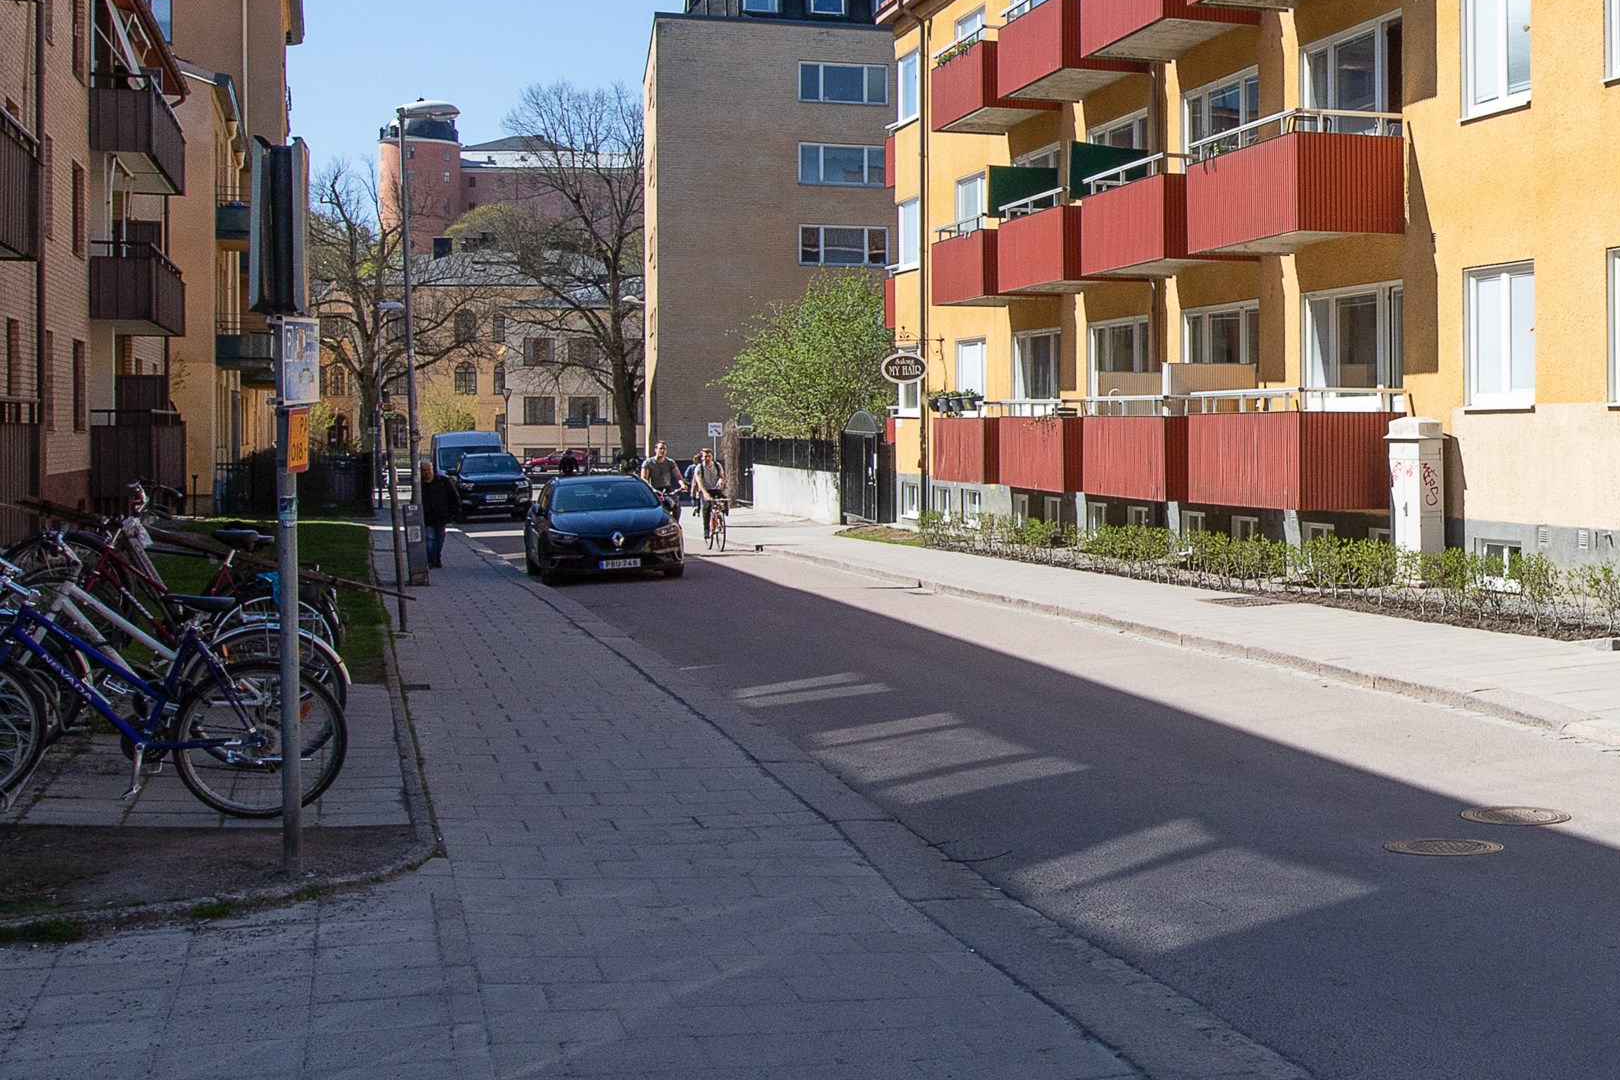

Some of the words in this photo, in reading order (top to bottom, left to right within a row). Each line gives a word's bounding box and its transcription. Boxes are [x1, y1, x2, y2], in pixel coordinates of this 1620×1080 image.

[888, 365, 900, 376] MY
[902, 364, 922, 376] HAIR
[41, 653, 92, 701] NEVADA
